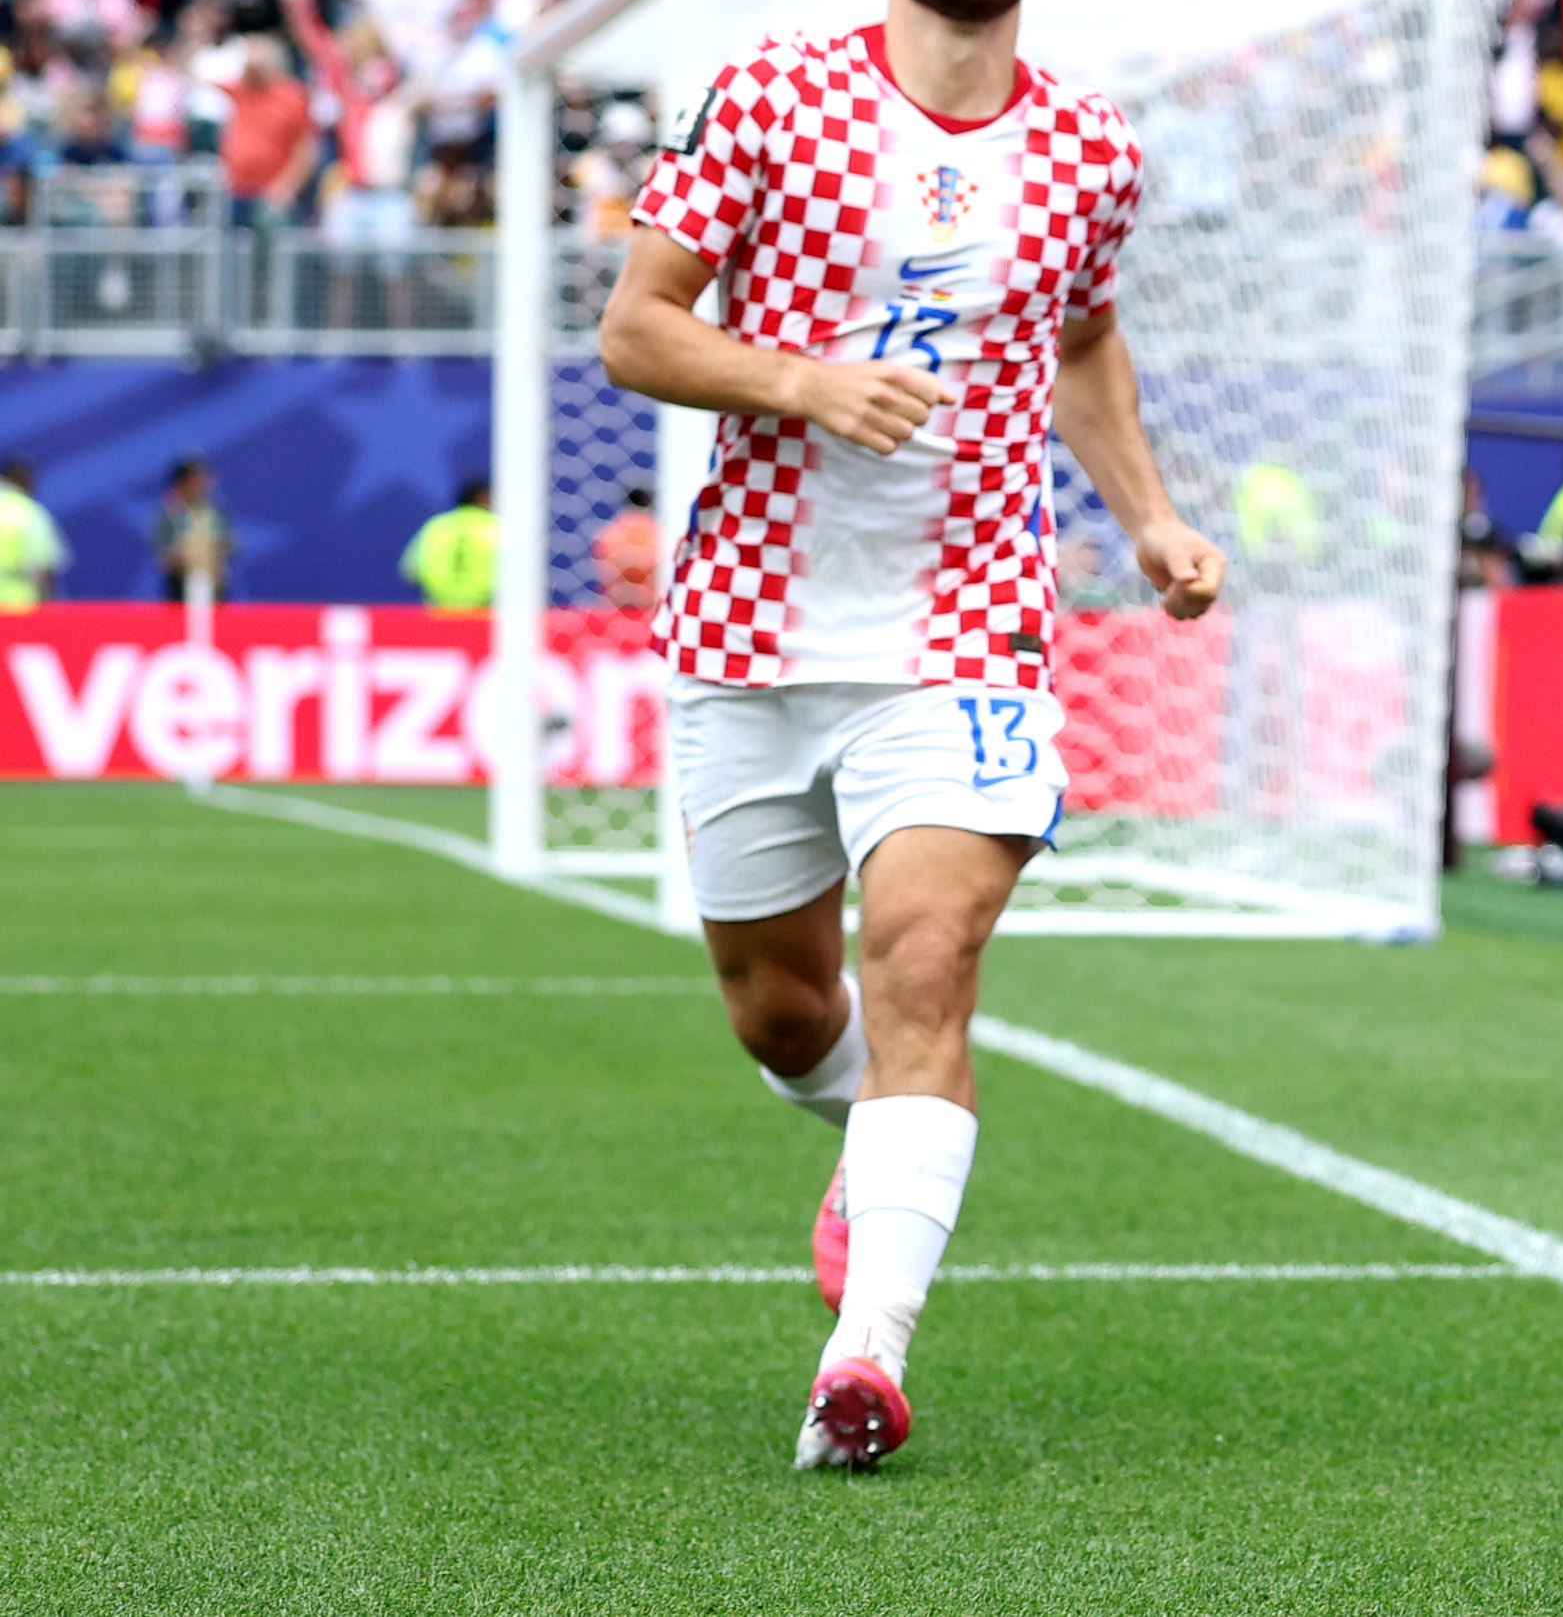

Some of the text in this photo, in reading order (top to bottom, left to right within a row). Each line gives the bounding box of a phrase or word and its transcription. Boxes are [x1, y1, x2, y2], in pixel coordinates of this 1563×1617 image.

[870, 301, 959, 374] 13
[8, 604, 668, 780] verizon
[957, 697, 1038, 774] 13
